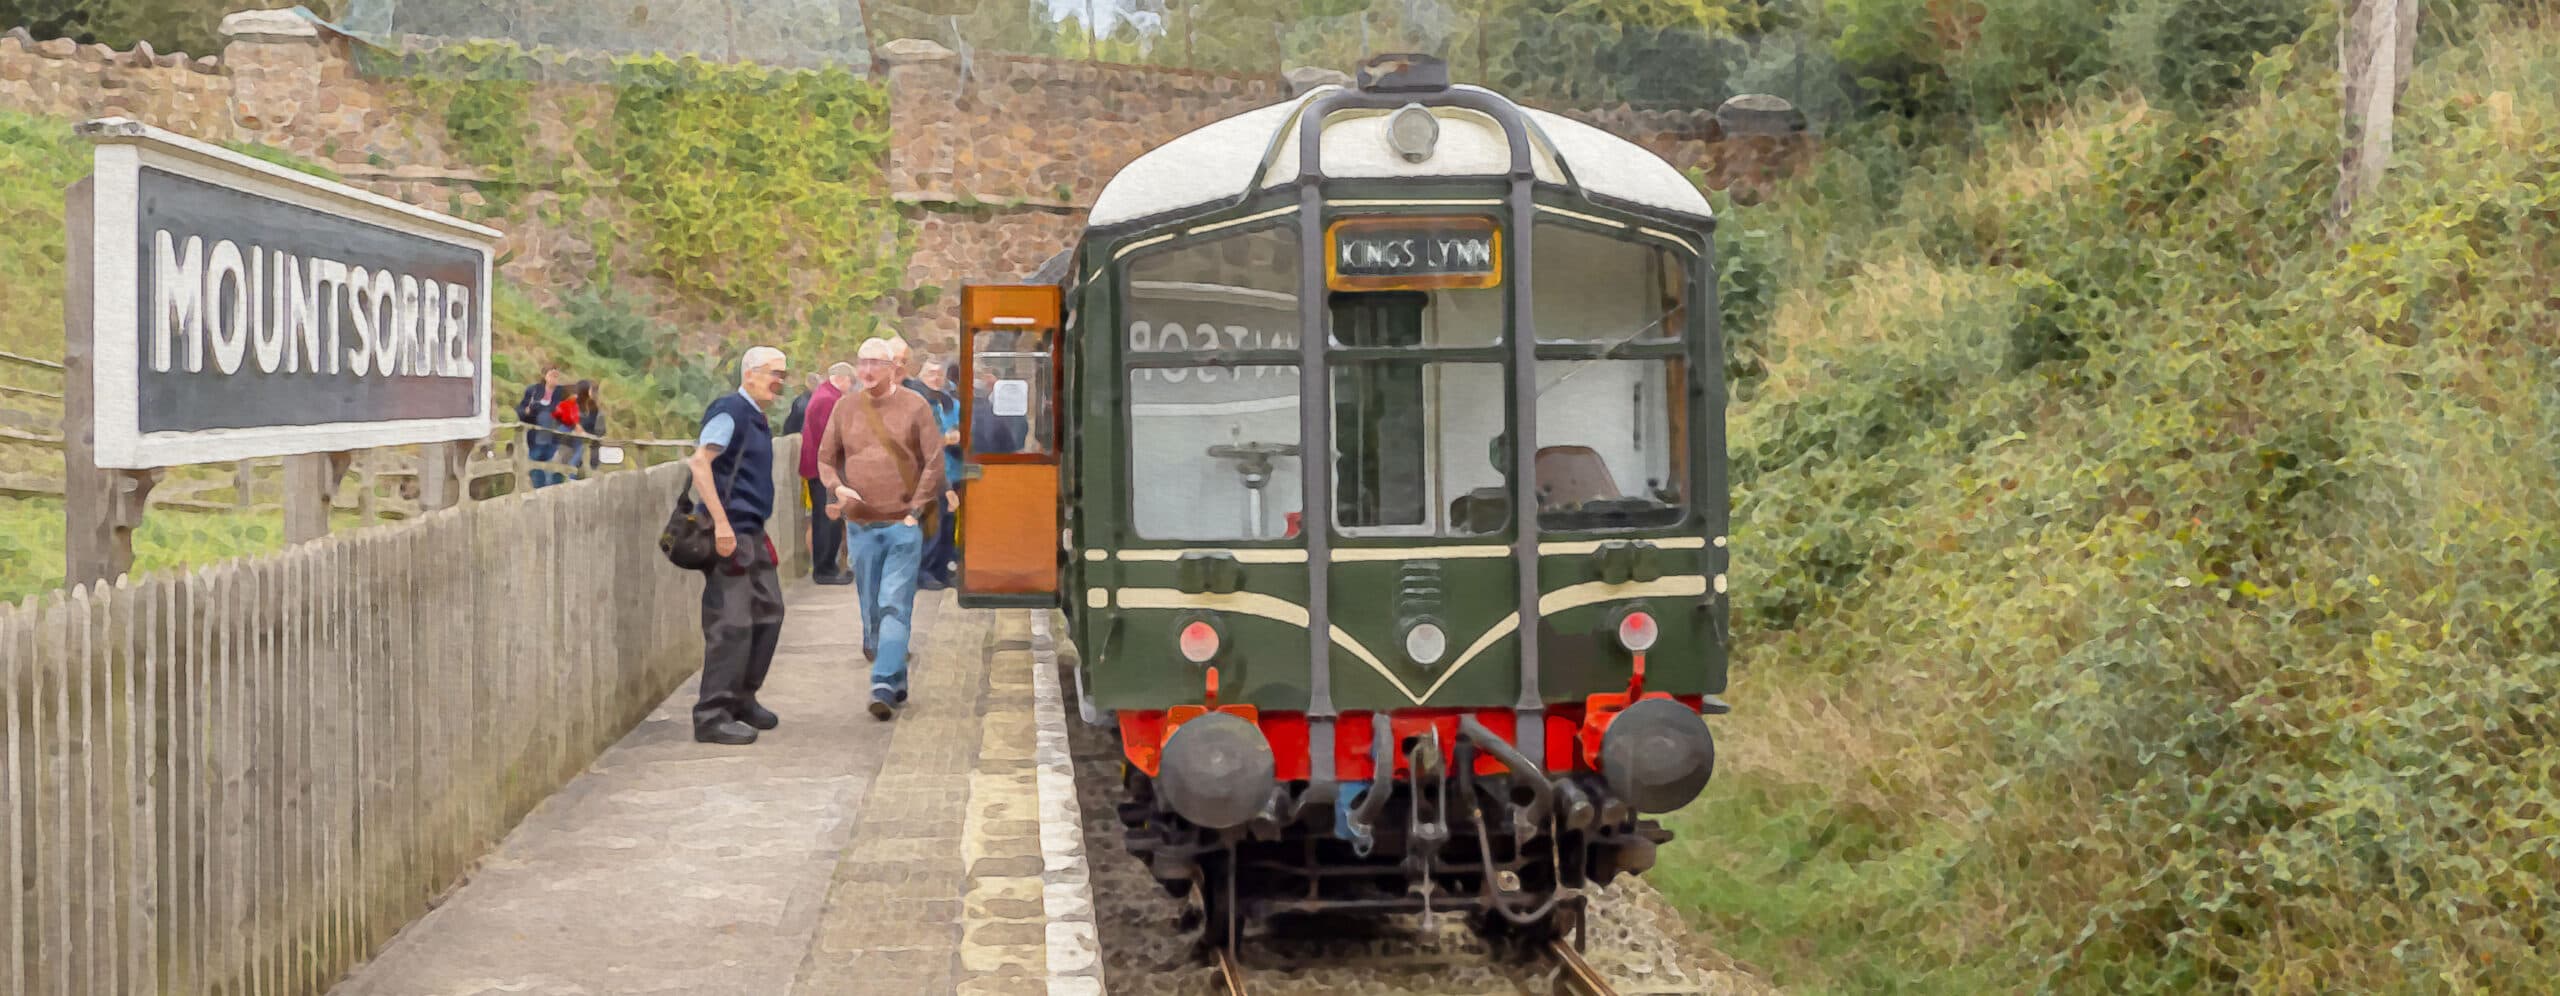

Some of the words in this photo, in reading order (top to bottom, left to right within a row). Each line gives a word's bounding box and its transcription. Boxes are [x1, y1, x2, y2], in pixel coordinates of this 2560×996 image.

[1342, 239, 1415, 268] KINGS
[1427, 239, 1490, 267] LYNN
[153, 229, 475, 377] MOUNTSORREL
